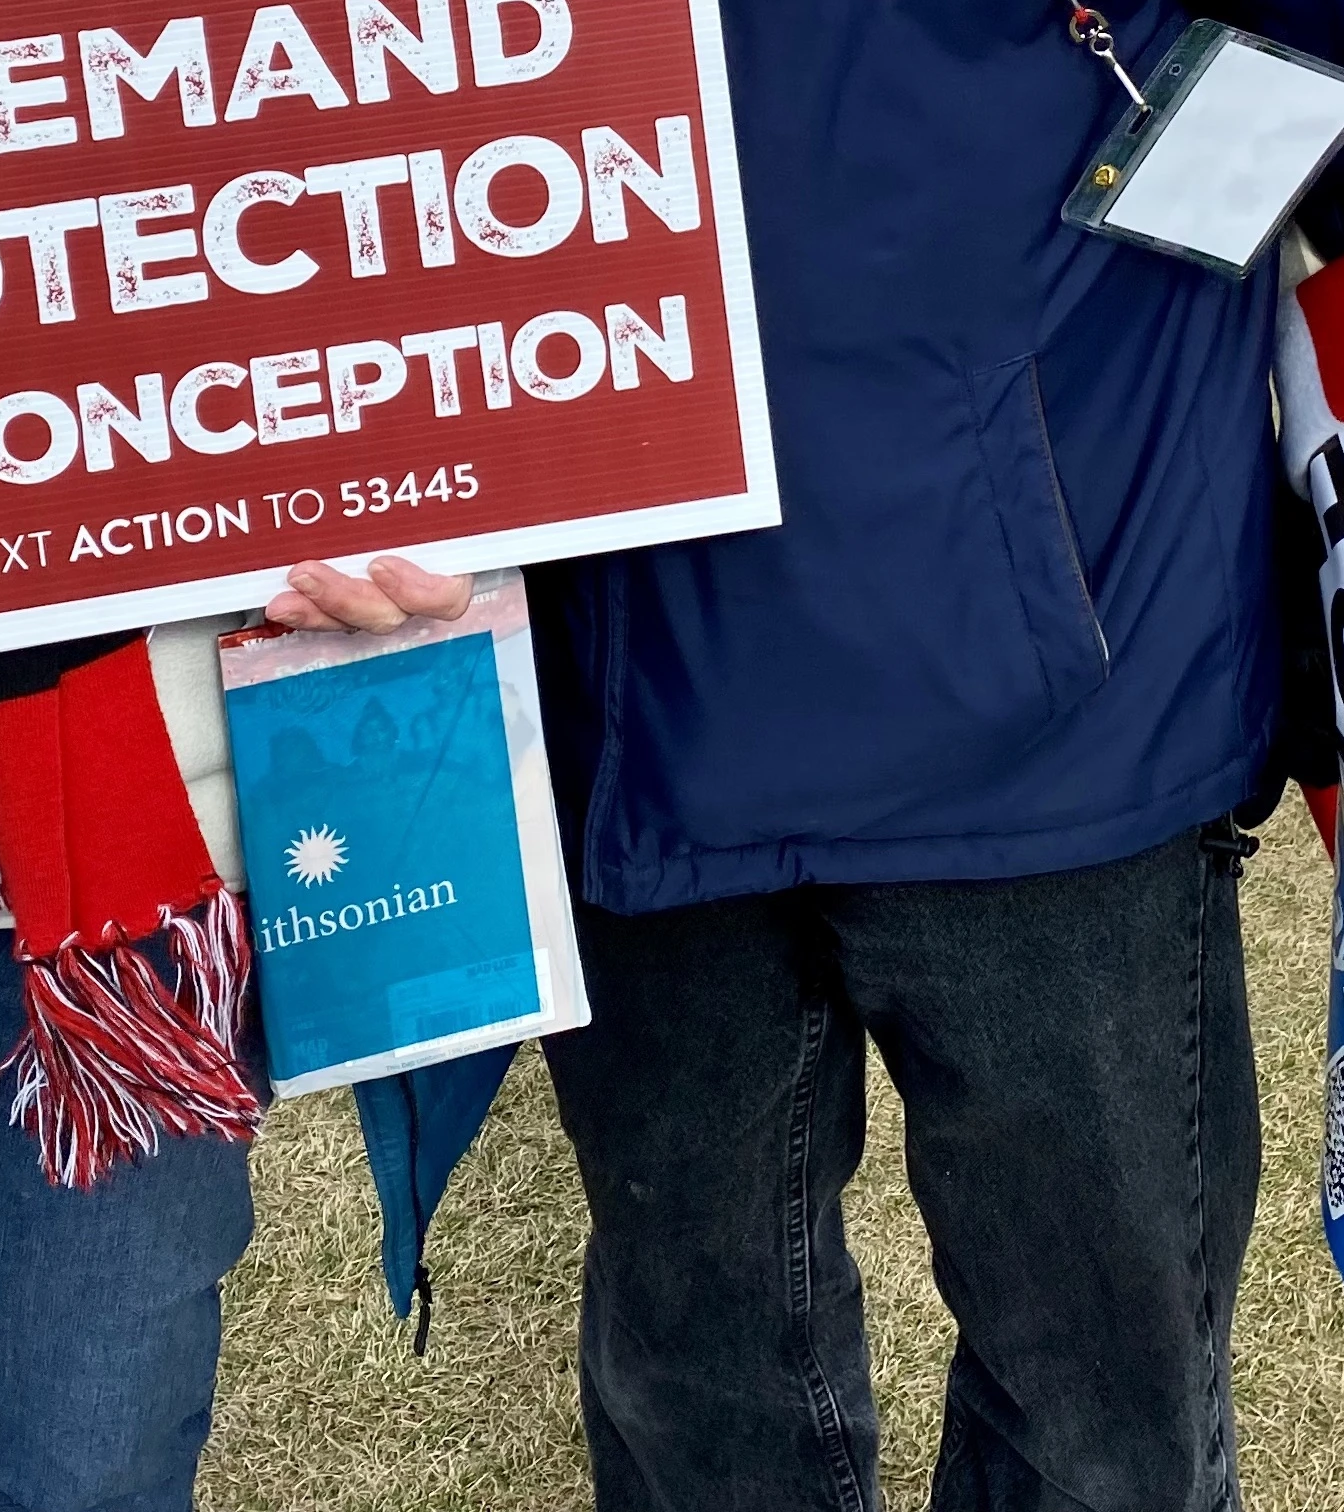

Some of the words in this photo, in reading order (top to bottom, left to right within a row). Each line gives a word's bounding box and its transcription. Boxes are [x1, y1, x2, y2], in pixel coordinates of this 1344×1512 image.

[69, 498, 250, 563] ACTION
[262, 488, 325, 529] TO
[340, 462, 479, 518] 53445
[250, 879, 458, 954] ithsonian
